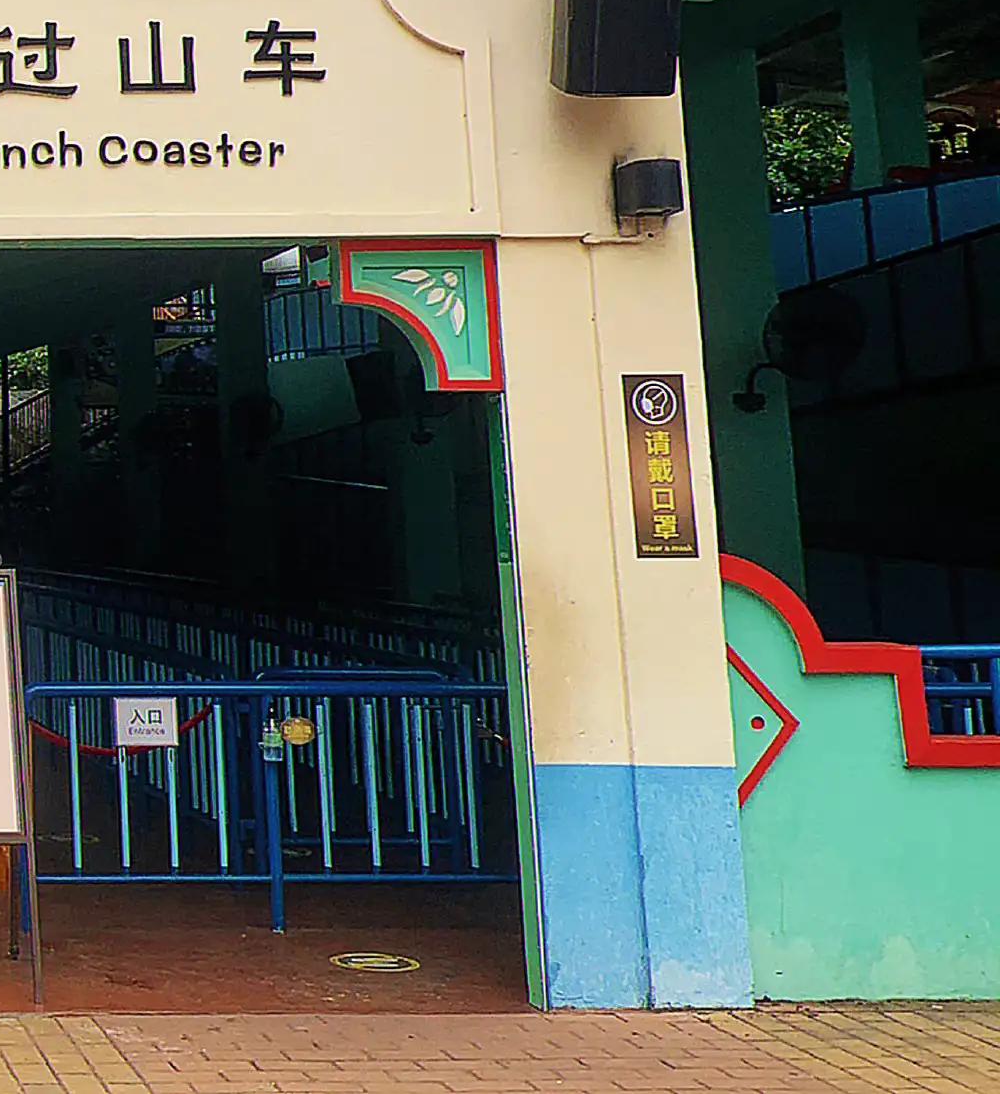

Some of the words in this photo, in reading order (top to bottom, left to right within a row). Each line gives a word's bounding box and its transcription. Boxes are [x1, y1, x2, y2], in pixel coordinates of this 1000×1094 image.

[99, 133, 285, 168] Coaster
[644, 431, 679, 539] 请戴口罩
[130, 709, 162, 724] 入口
